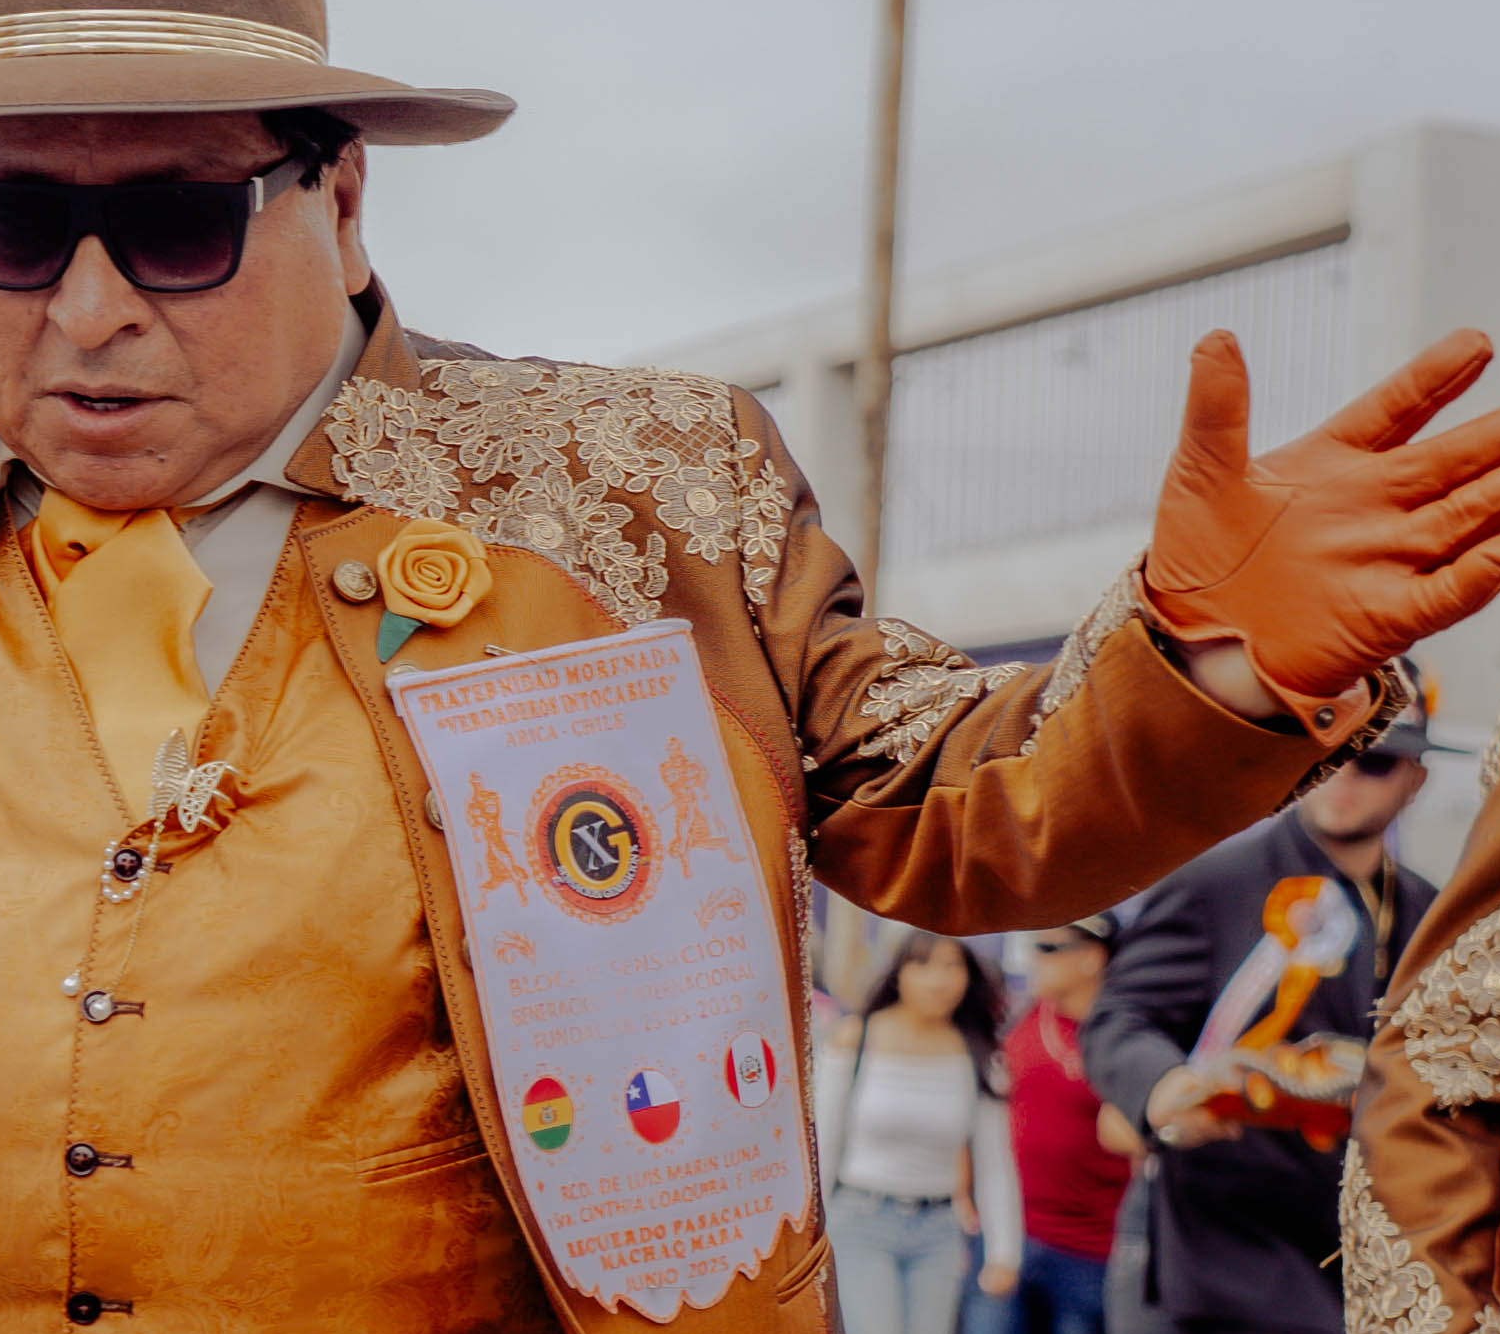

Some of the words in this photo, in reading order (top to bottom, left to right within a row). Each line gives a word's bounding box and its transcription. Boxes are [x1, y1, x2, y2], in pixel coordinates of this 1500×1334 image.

[418, 665, 561, 714] FRATERNIDAD
[565, 647, 681, 686] MORENADA
[504, 725, 558, 748] ARICA
[570, 711, 628, 738] CHILE
[599, 1174, 621, 1196] DE
[625, 1167, 663, 1192] LUIS
[722, 1144, 761, 1170] LUNA
[566, 1223, 668, 1259] RECUERDO
[673, 1195, 774, 1237] PASACALLE
[690, 1224, 744, 1253] MARA
[624, 1268, 680, 1294] JUNIO
[687, 1255, 730, 1280] 2025
